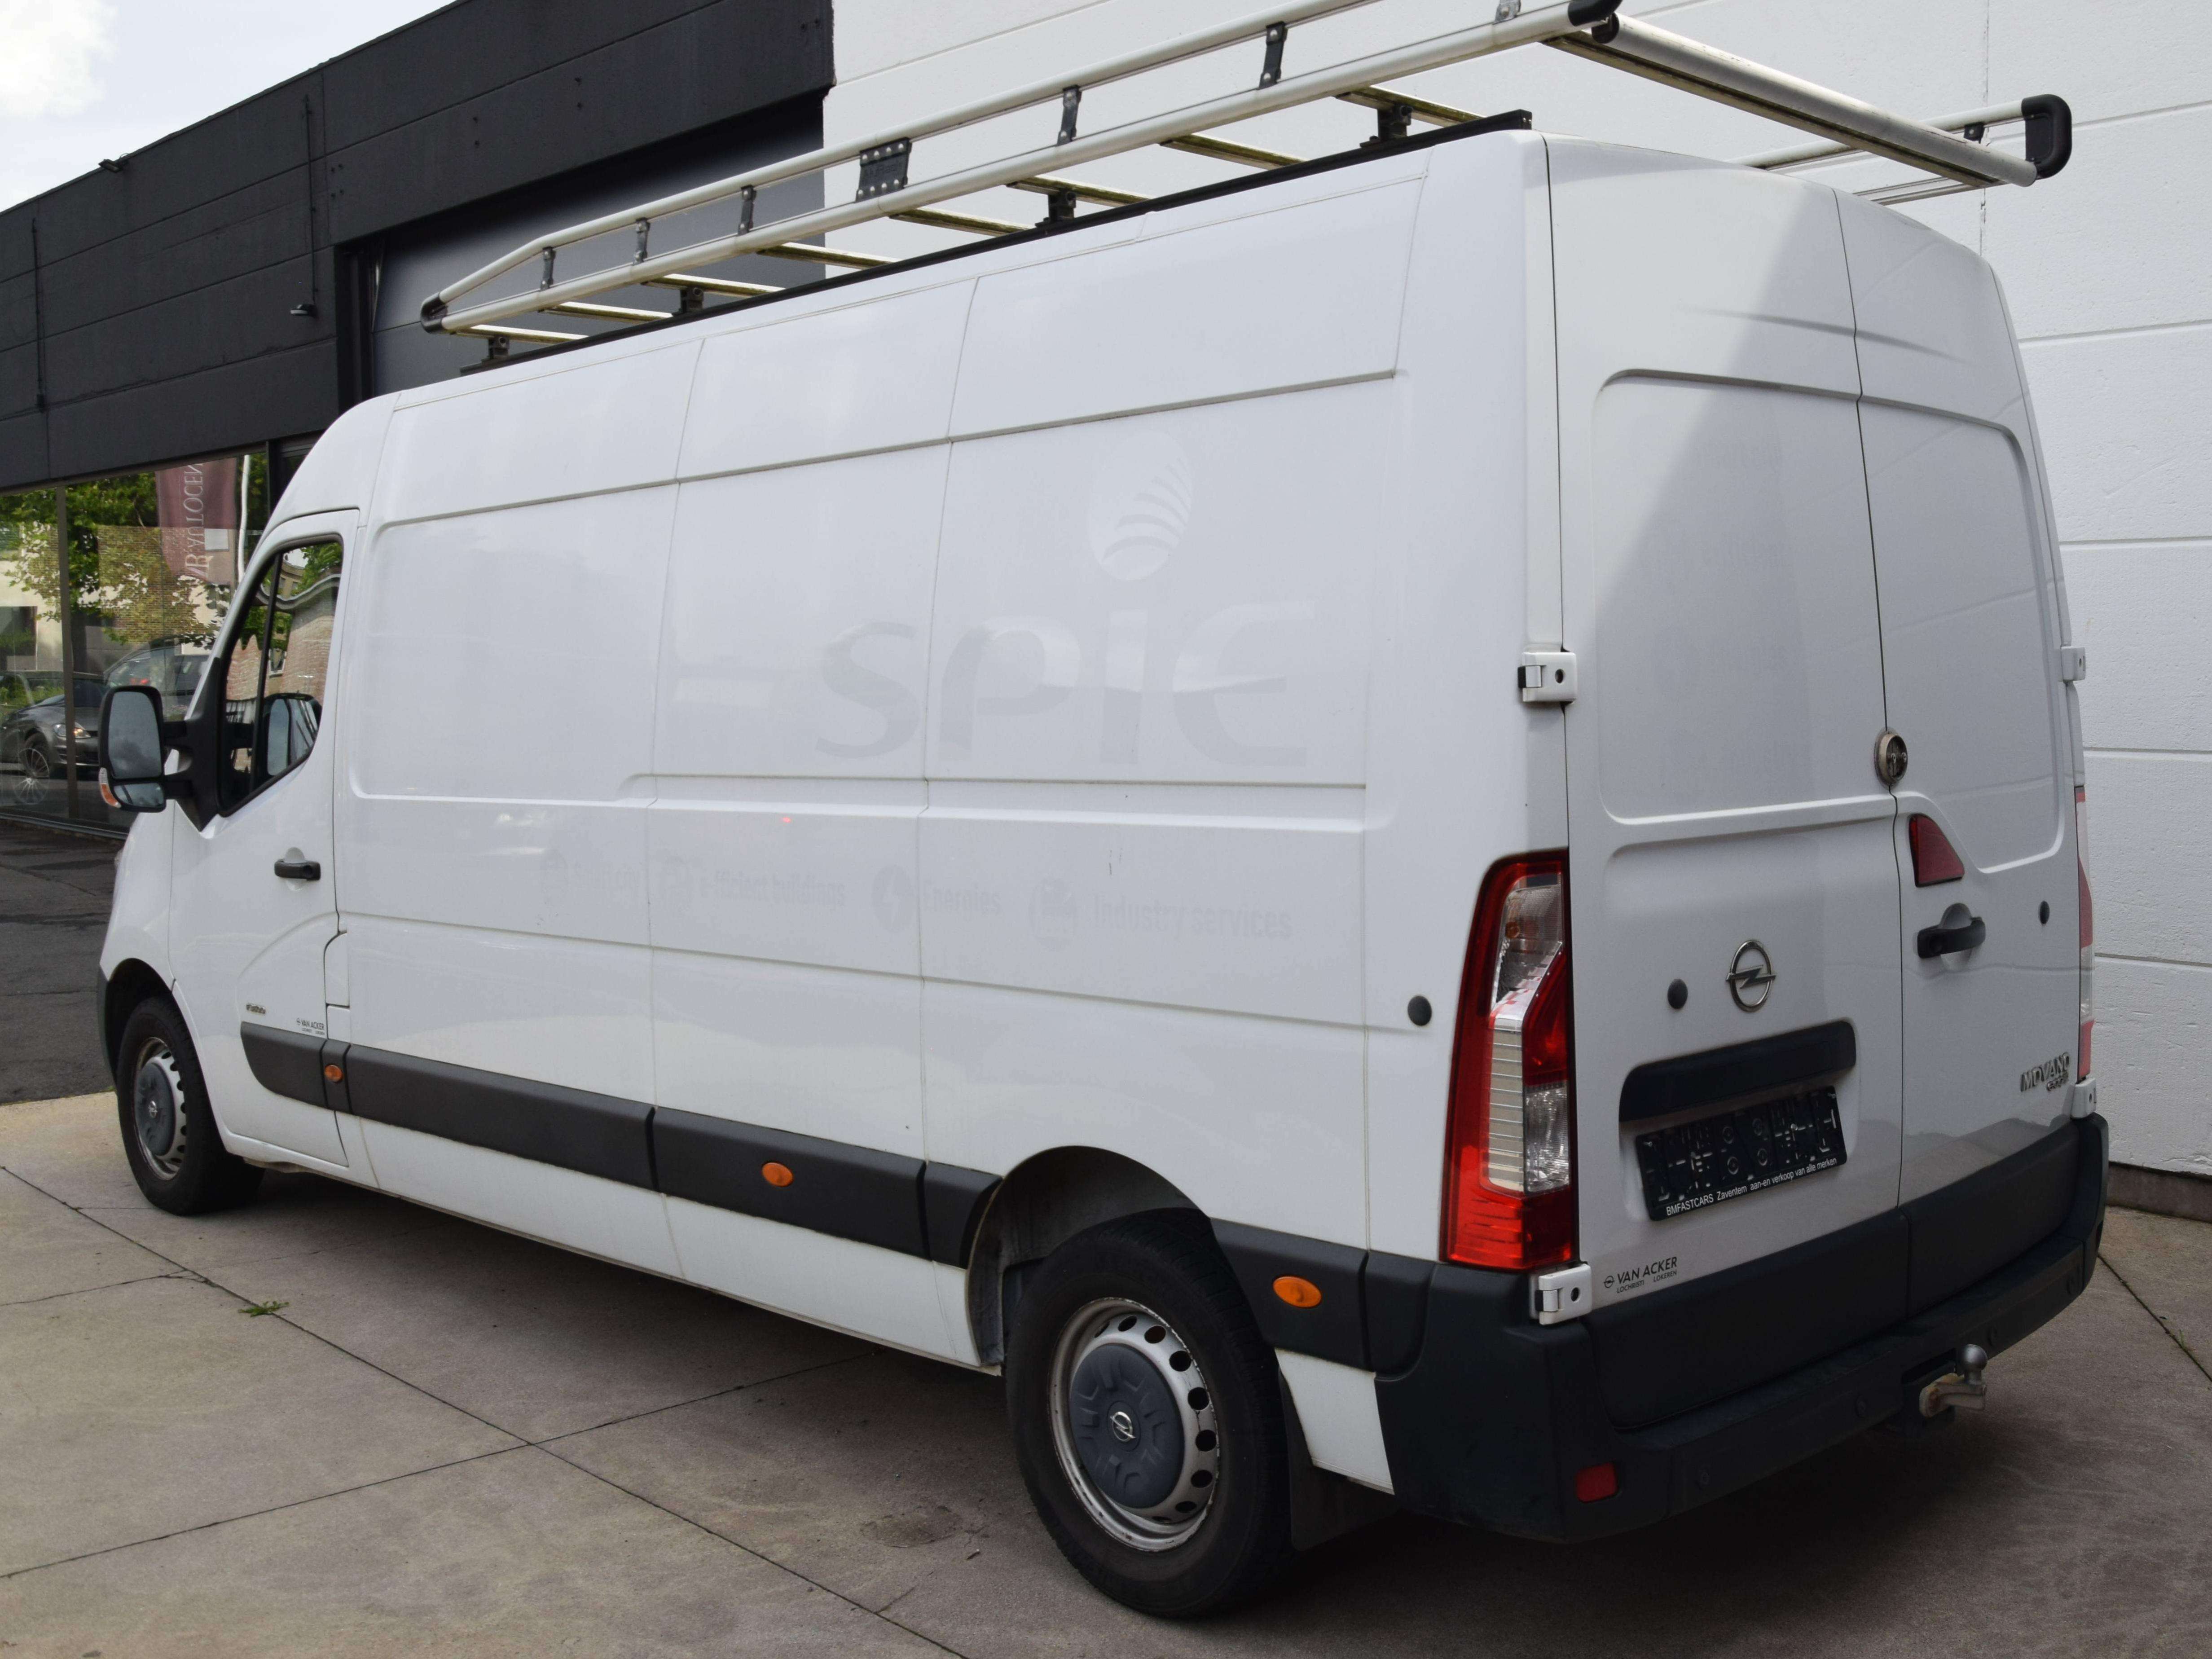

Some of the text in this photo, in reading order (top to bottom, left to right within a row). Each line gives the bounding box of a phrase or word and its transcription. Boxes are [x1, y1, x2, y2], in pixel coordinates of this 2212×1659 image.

[1094, 893, 1293, 940] Industry services
[2020, 1052, 2070, 1092] MOVANO
[1666, 1194, 1714, 1216] BMFASTCARS
[1717, 1186, 1747, 1201] Zaventem
[1772, 1171, 1794, 1184] verkoop
[1795, 1168, 1805, 1177] van
[1806, 1163, 1816, 1173] alle
[1817, 1158, 1837, 1170] merken
[1617, 1257, 1677, 1285] VAN ACKER
[1617, 1270, 1677, 1294] LOCHRISTI LOKEREN
